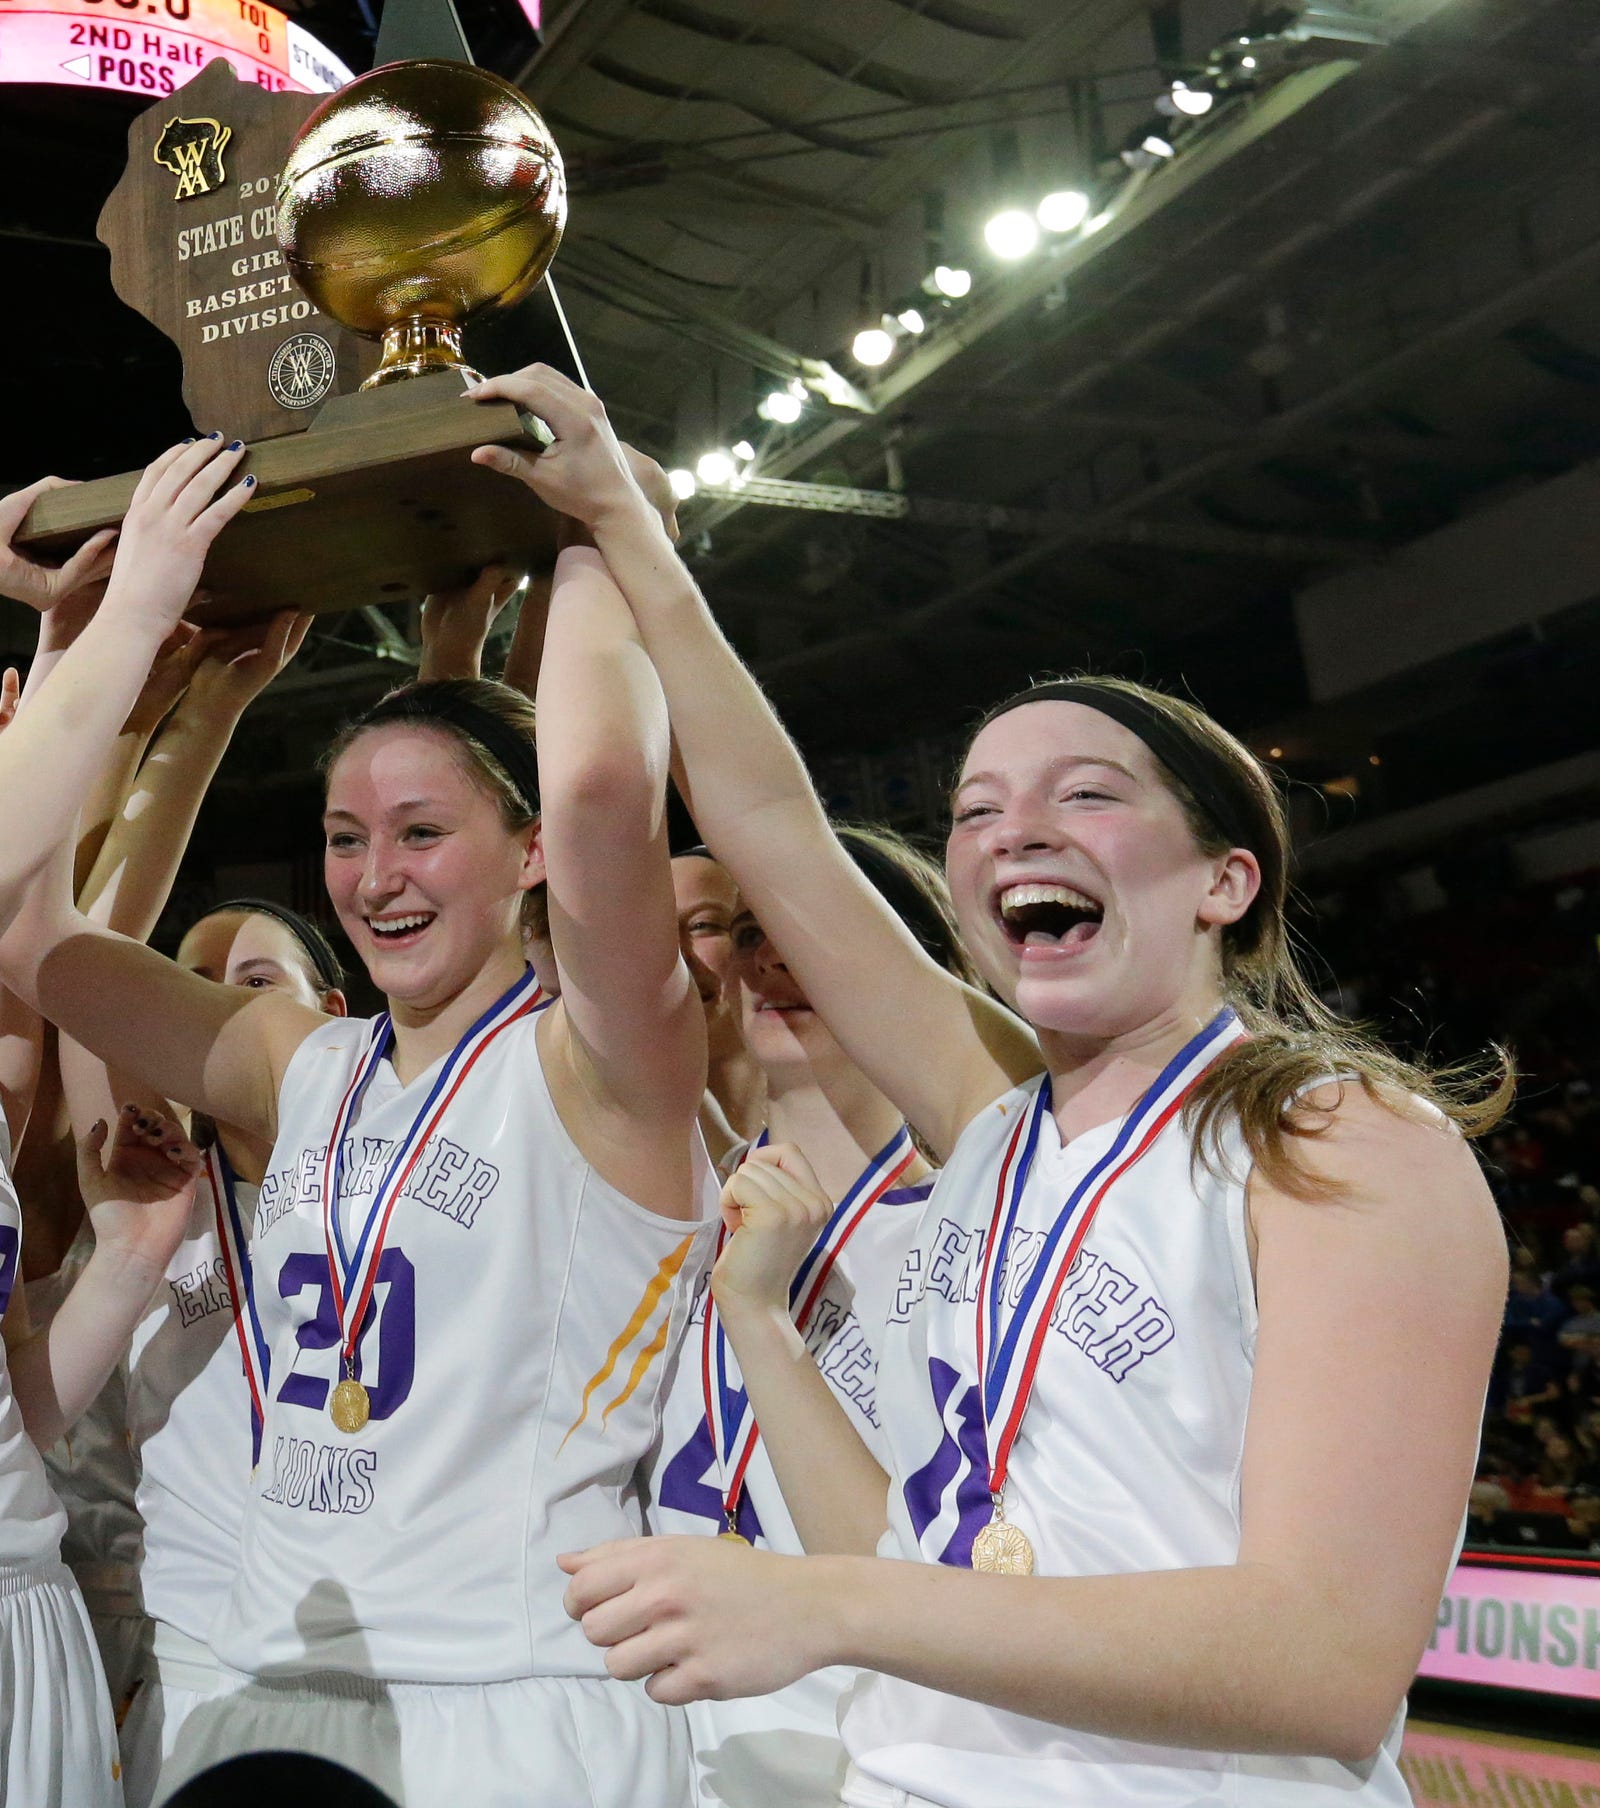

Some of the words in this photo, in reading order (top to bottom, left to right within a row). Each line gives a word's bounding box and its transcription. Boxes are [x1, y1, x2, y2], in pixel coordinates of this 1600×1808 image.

[238, 0, 270, 31] TOL
[69, 23, 131, 50] 2ND
[143, 33, 203, 67] Half
[99, 55, 175, 93] POSS
[178, 214, 244, 262] STATE
[277, 1247, 415, 1421] 20
[261, 1435, 376, 1514] LIONS
